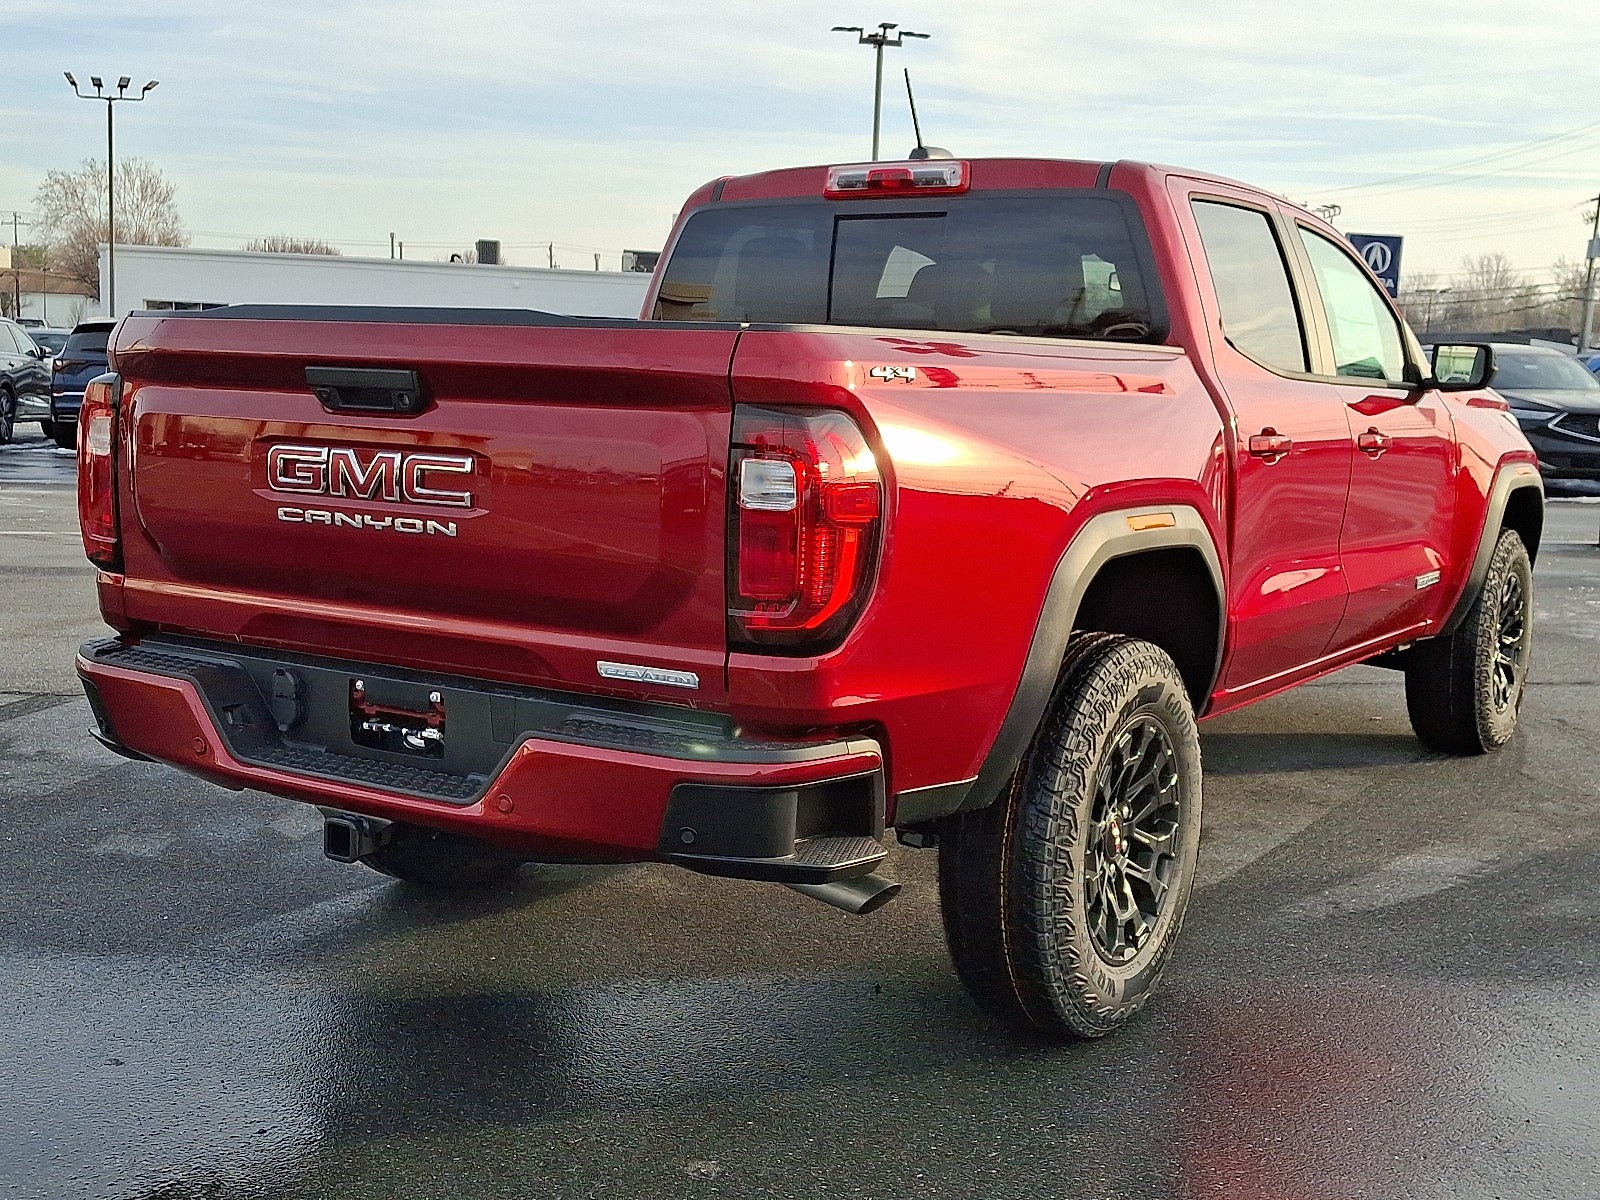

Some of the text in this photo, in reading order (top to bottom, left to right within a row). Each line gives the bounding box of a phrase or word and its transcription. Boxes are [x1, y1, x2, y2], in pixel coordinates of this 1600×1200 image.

[267, 444, 473, 508] GMC
[277, 507, 457, 537] CANYON
[603, 667, 691, 684] ELEVATION
